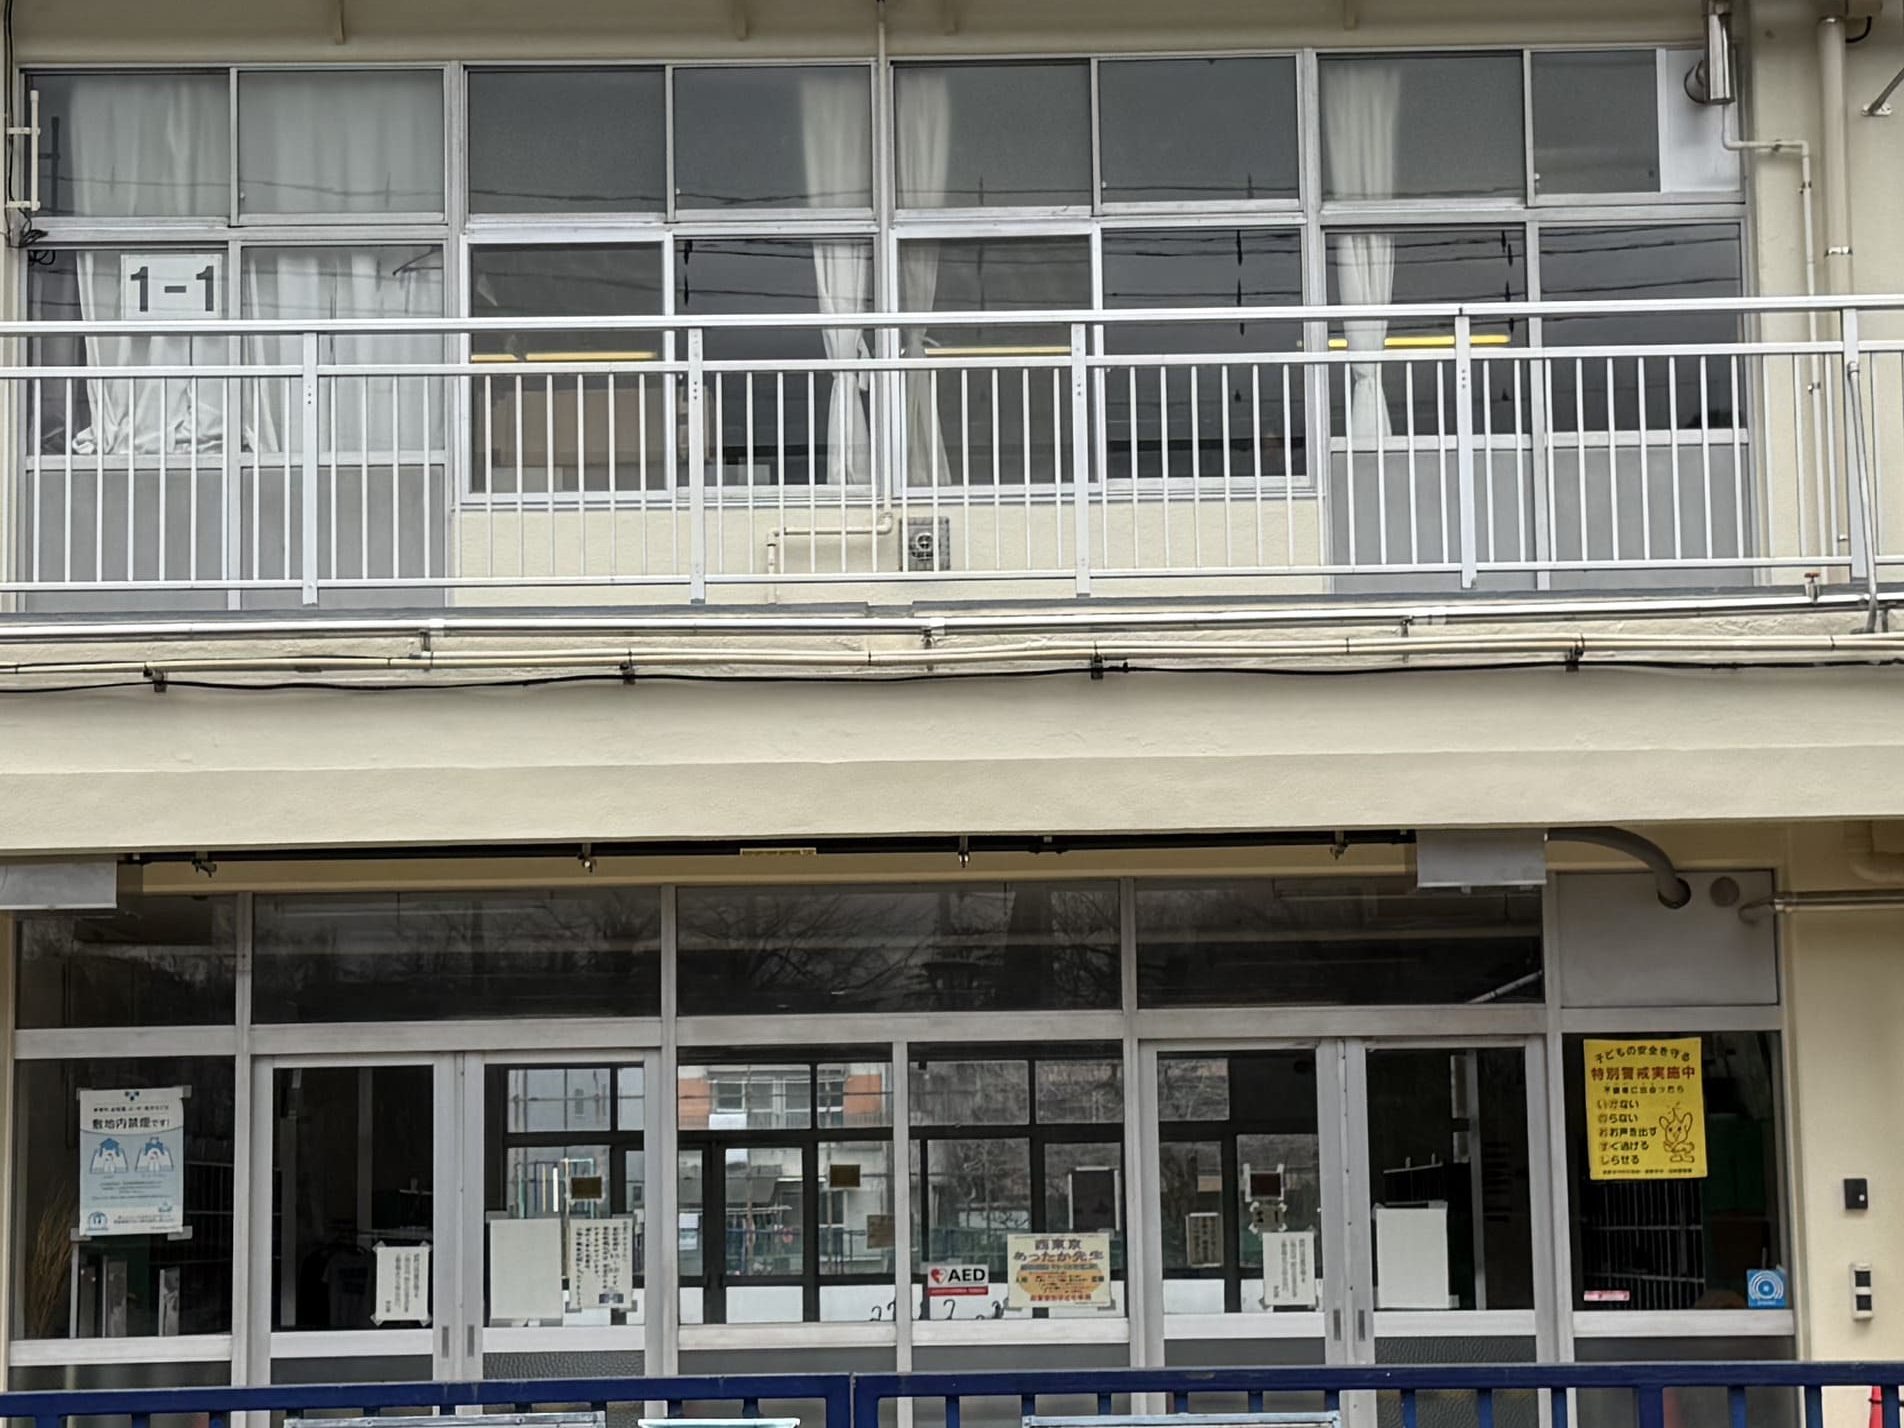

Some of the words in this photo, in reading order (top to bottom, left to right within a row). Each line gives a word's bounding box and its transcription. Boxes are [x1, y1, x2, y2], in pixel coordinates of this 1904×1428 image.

[130, 265, 215, 312] 1-1
[1590, 1065, 1695, 1081] 特別警戒実施中
[948, 1268, 985, 1282] AED
